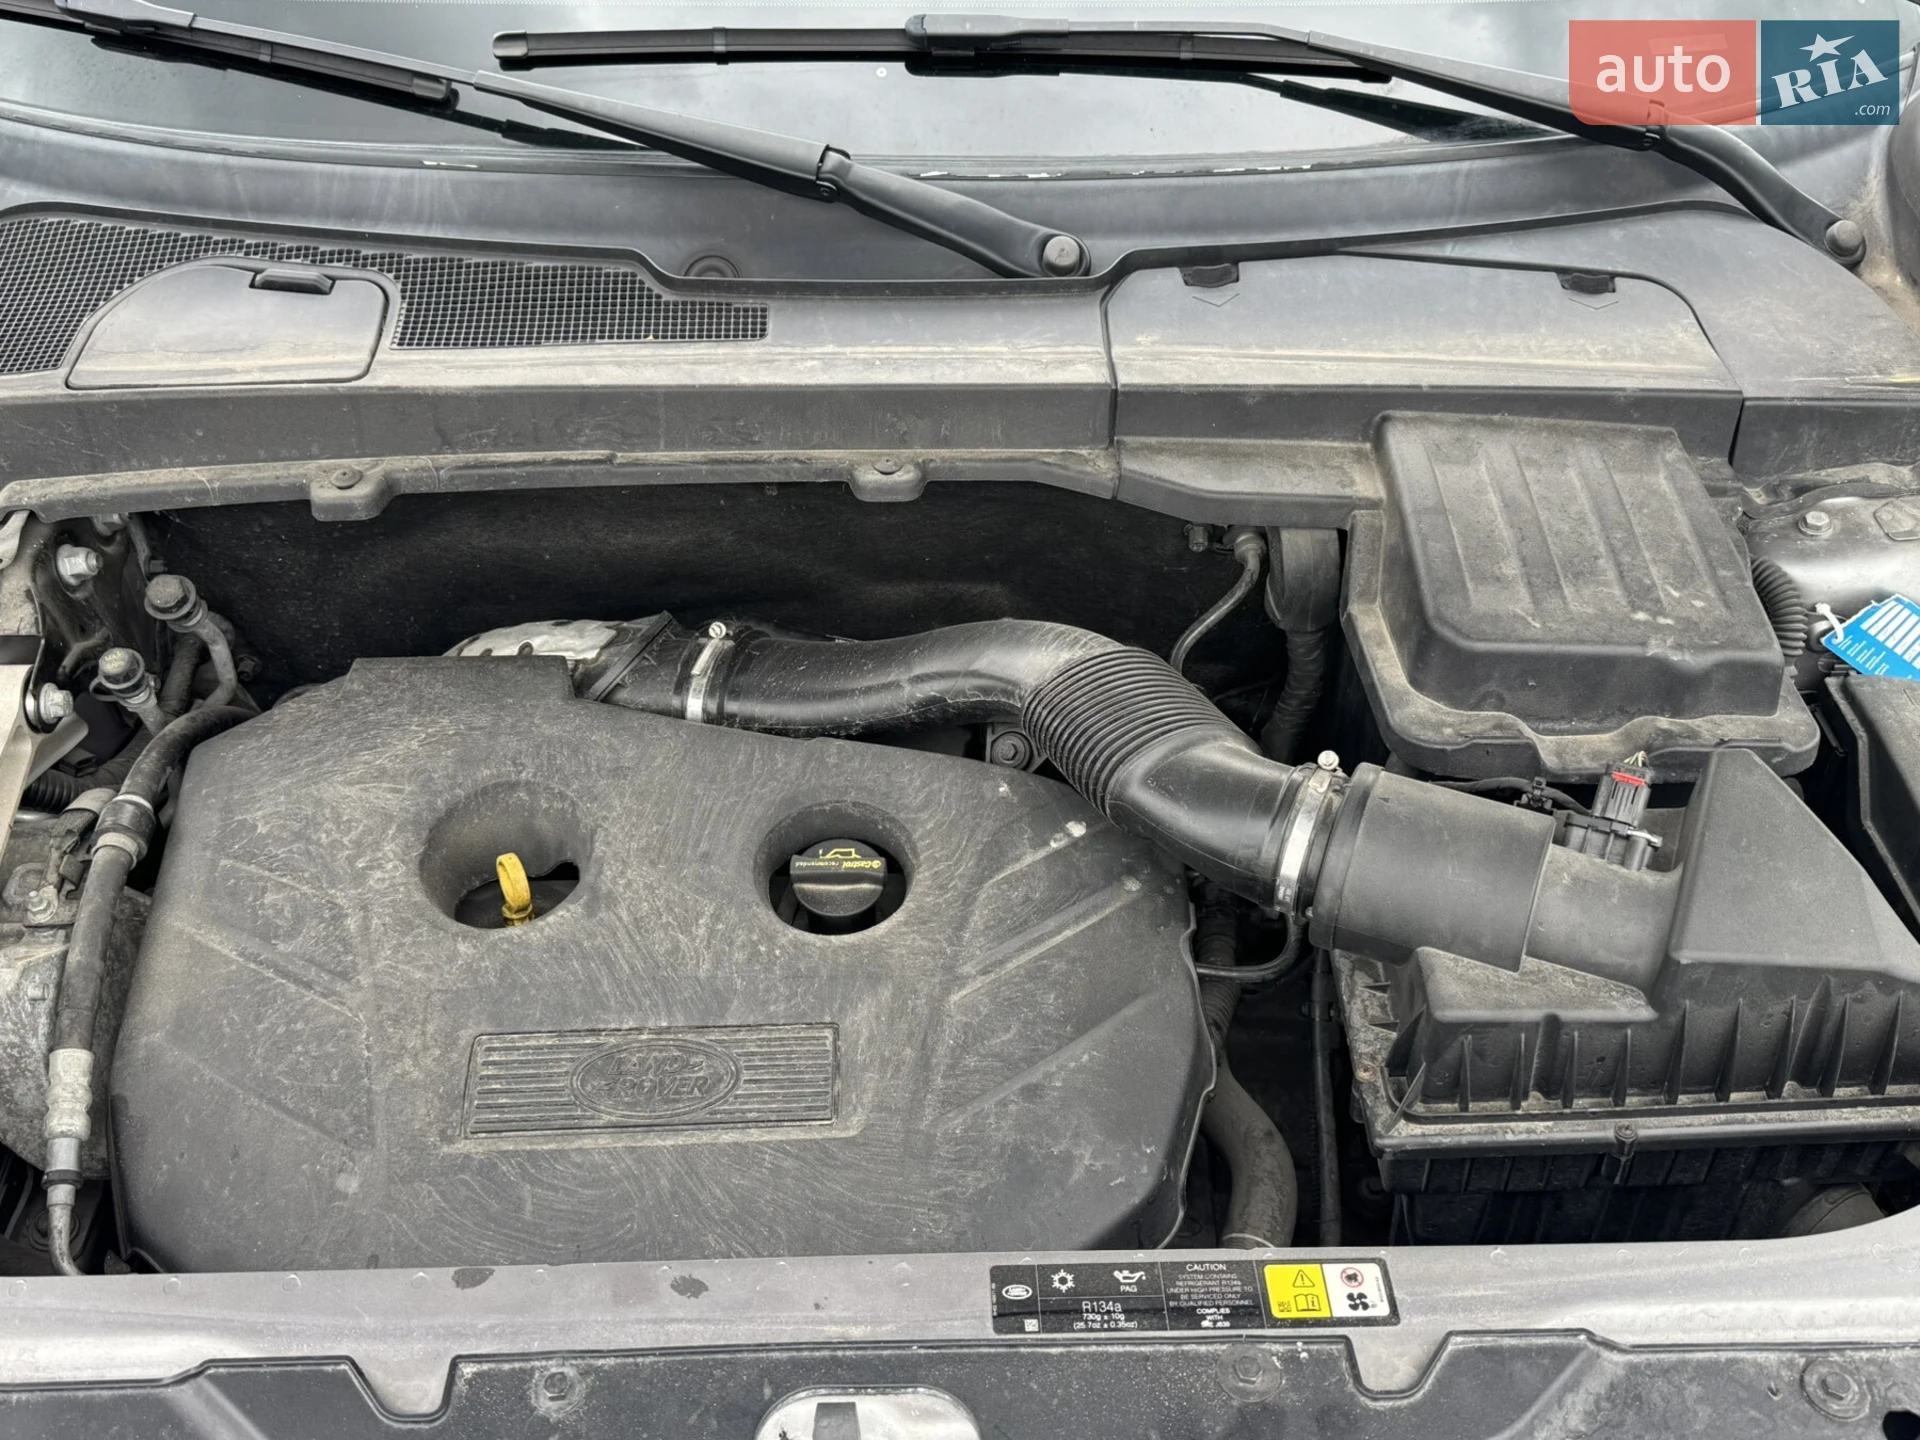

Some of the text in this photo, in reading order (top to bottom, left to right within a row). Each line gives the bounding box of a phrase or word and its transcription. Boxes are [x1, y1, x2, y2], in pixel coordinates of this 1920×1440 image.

[609, 1053, 687, 1076] LAND
[614, 1075, 711, 1098] ROVER
[1186, 1263, 1226, 1271] CAUTION
[1082, 1300, 1122, 1312] R134a
[1082, 1313, 1101, 1321] 730g
[1111, 1313, 1125, 1321] 10g
[1073, 1321, 1101, 1330] (25.7oz
[1109, 1321, 1138, 1329] 0.35oz)
